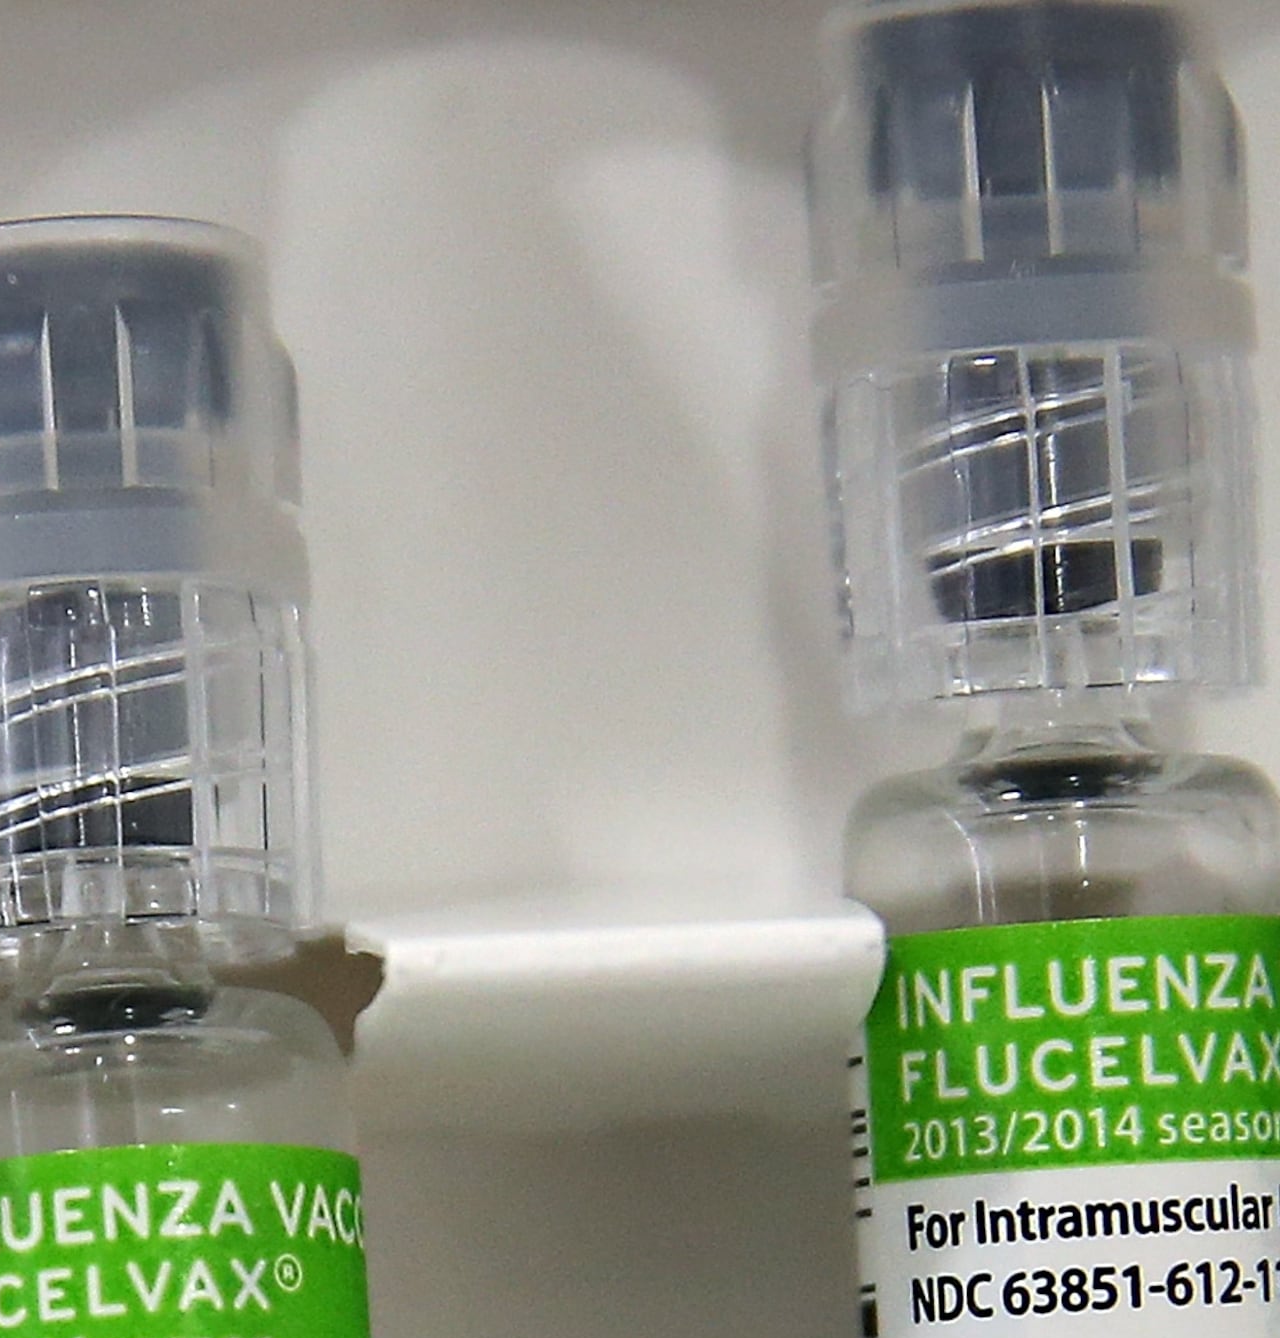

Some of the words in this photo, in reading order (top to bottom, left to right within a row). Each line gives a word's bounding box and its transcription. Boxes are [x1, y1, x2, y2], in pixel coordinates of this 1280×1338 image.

[896, 952, 1274, 1029] INFLUENZA
[904, 1106, 1145, 1162] 2013/2014
[908, 1203, 965, 1250] For
[976, 1184, 1273, 1245] Intramuscular
[911, 1273, 994, 1324] NDC
